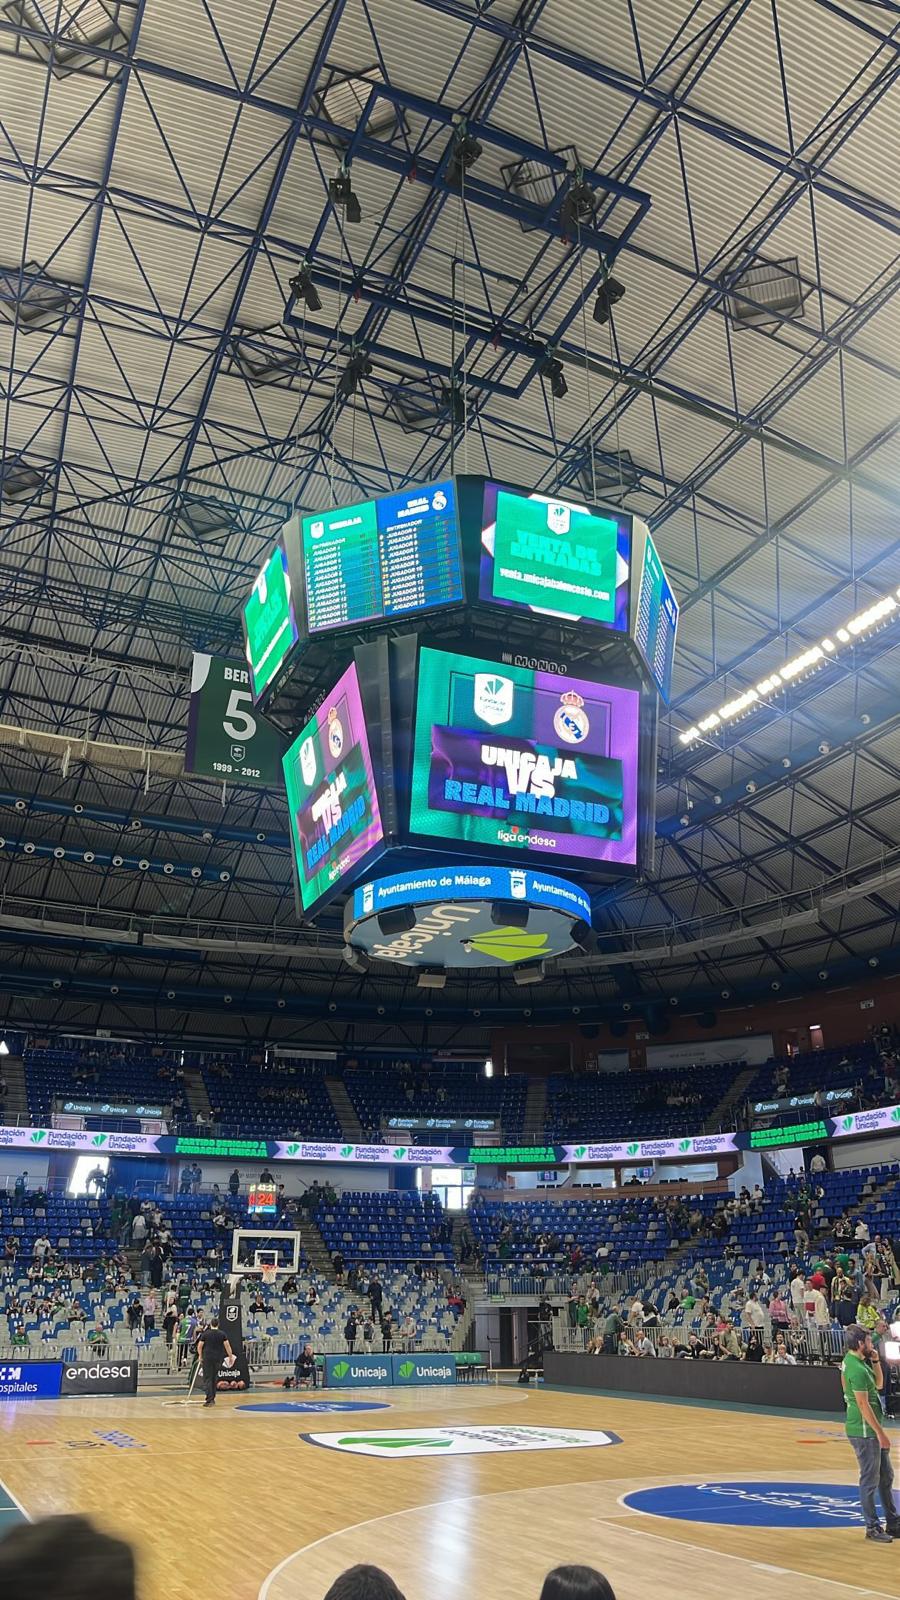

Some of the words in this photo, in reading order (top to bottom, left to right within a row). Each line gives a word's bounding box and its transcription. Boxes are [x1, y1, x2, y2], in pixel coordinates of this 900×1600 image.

[514, 655, 568, 675] MONDO
[224, 667, 250, 684] BER
[223, 689, 257, 741] 5
[480, 744, 578, 780] UNICAJA
[213, 762, 233, 773] 1999
[241, 767, 261, 778] 2012
[504, 764, 556, 799] VS
[444, 779, 510, 810] REAL
[515, 791, 610, 824] MADRID
[378, 879, 437, 898] Ayuntamiento
[440, 876, 453, 887] de
[454, 874, 492, 887] Málaga
[532, 880, 577, 903] Ayuntamiento
[373, 905, 481, 958] Unicaja
[0, 1129, 25, 1138] dación
[49, 1131, 87, 1141] Fundación
[0, 1137, 13, 1145] caja
[48, 1138, 76, 1147] Unicaja
[109, 1135, 147, 1143] Fundación
[693, 1137, 726, 1145] Fundación
[109, 1142, 136, 1151] Unicaja
[301, 1144, 337, 1152] Fundación
[641, 1141, 674, 1149] Fundación
[693, 1144, 717, 1152] Unicaja
[301, 1150, 327, 1159] Unicaja
[355, 1146, 389, 1154] Fundación
[408, 1148, 442, 1156] Fundación
[588, 1146, 622, 1154] Fundación
[641, 1148, 666, 1156] Unicaja
[355, 1153, 380, 1161] Unicaja
[408, 1155, 432, 1163] Unicaja
[588, 1152, 613, 1160] Unicaja
[257, 1193, 273, 1205] 24
[185, 1324, 191, 1333] 7
[66, 1364, 131, 1380] endesa
[218, 1369, 240, 1378] Unicaja
[351, 1366, 387, 1380] Unicaja
[416, 1366, 452, 1379] Unicaja
[0, 1382, 38, 1394] ospitales
